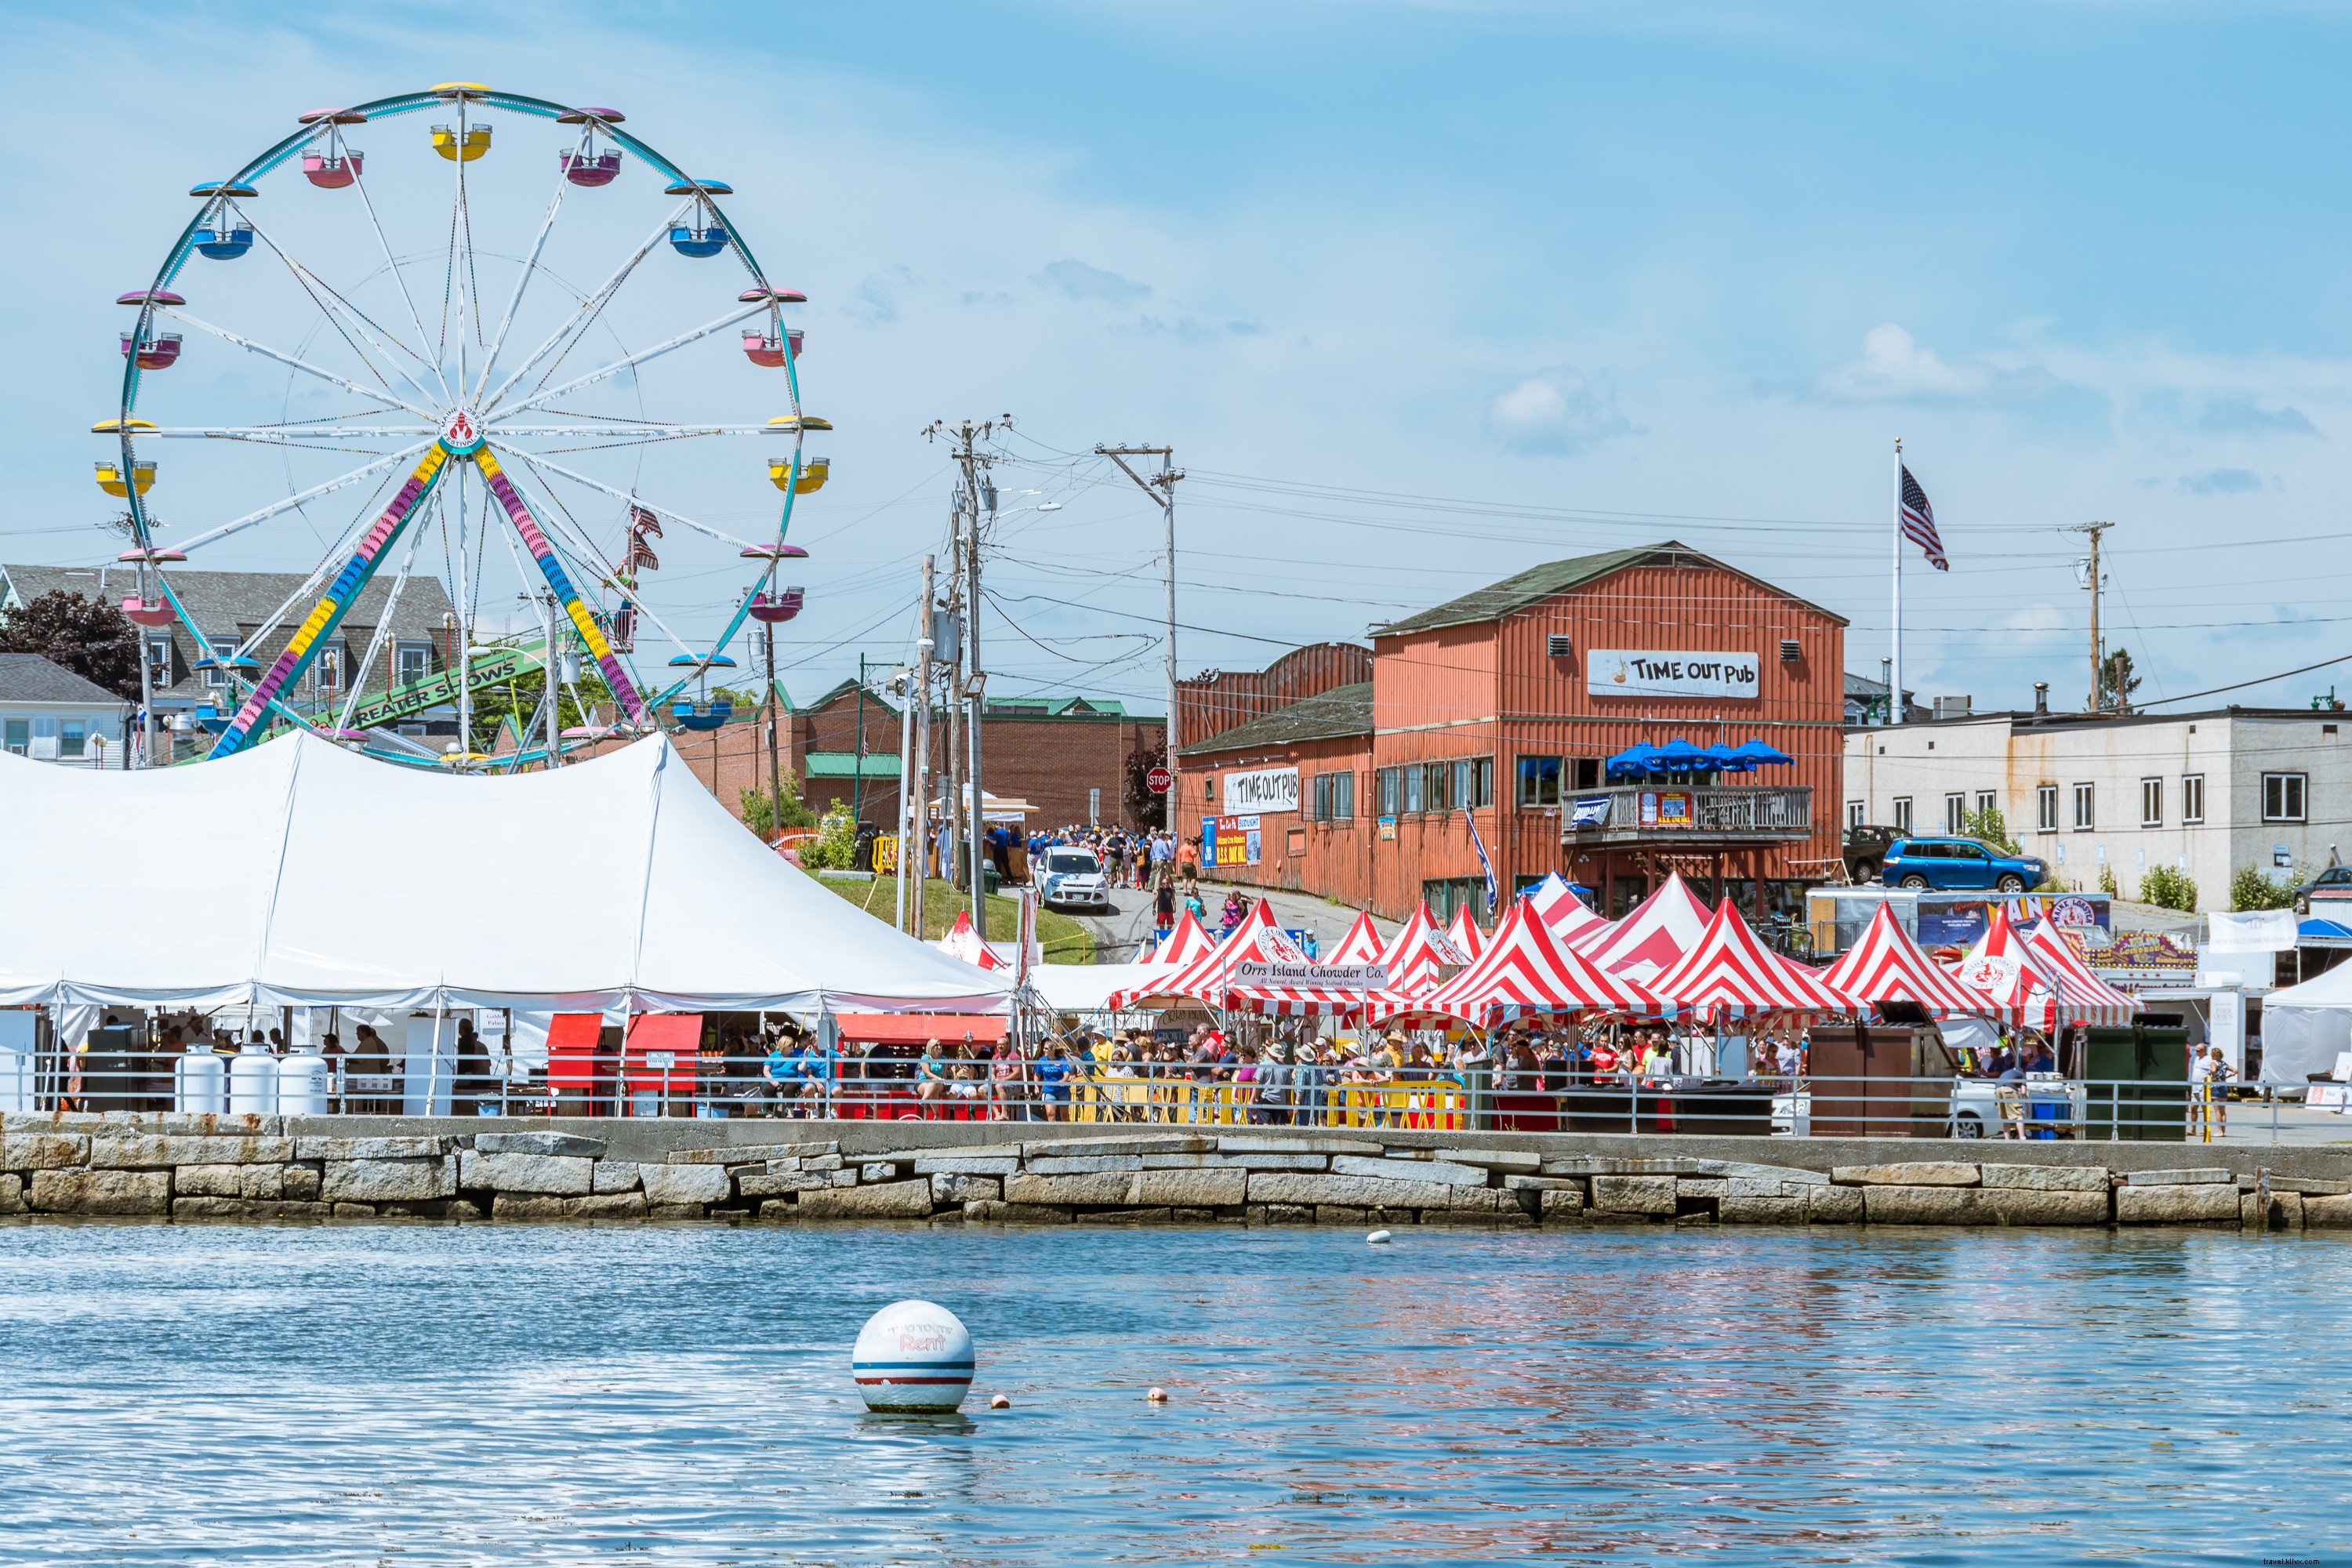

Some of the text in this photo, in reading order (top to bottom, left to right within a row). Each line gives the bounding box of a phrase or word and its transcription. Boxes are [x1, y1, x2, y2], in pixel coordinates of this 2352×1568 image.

[441, 406, 482, 435] MAINE LOBSTER
[444, 433, 477, 447] FESTIVAL
[1631, 659, 1684, 681] TIME
[1687, 662, 1722, 681] OUT
[435, 662, 516, 698] SHOWS
[1149, 776, 1170, 786] STOP
[1238, 772, 1298, 804] TIME OUT PUB
[1573, 806, 1590, 821] BUD
[1247, 818, 1259, 827] LIGHT
[1229, 846, 1238, 863] OAK
[2053, 898, 2093, 924] MAINE LOBSTER
[2119, 944, 2166, 956] Lemonade
[1241, 963, 1384, 978] Orrs Island Chowder Co.
[900, 1334, 946, 1352] Rent
